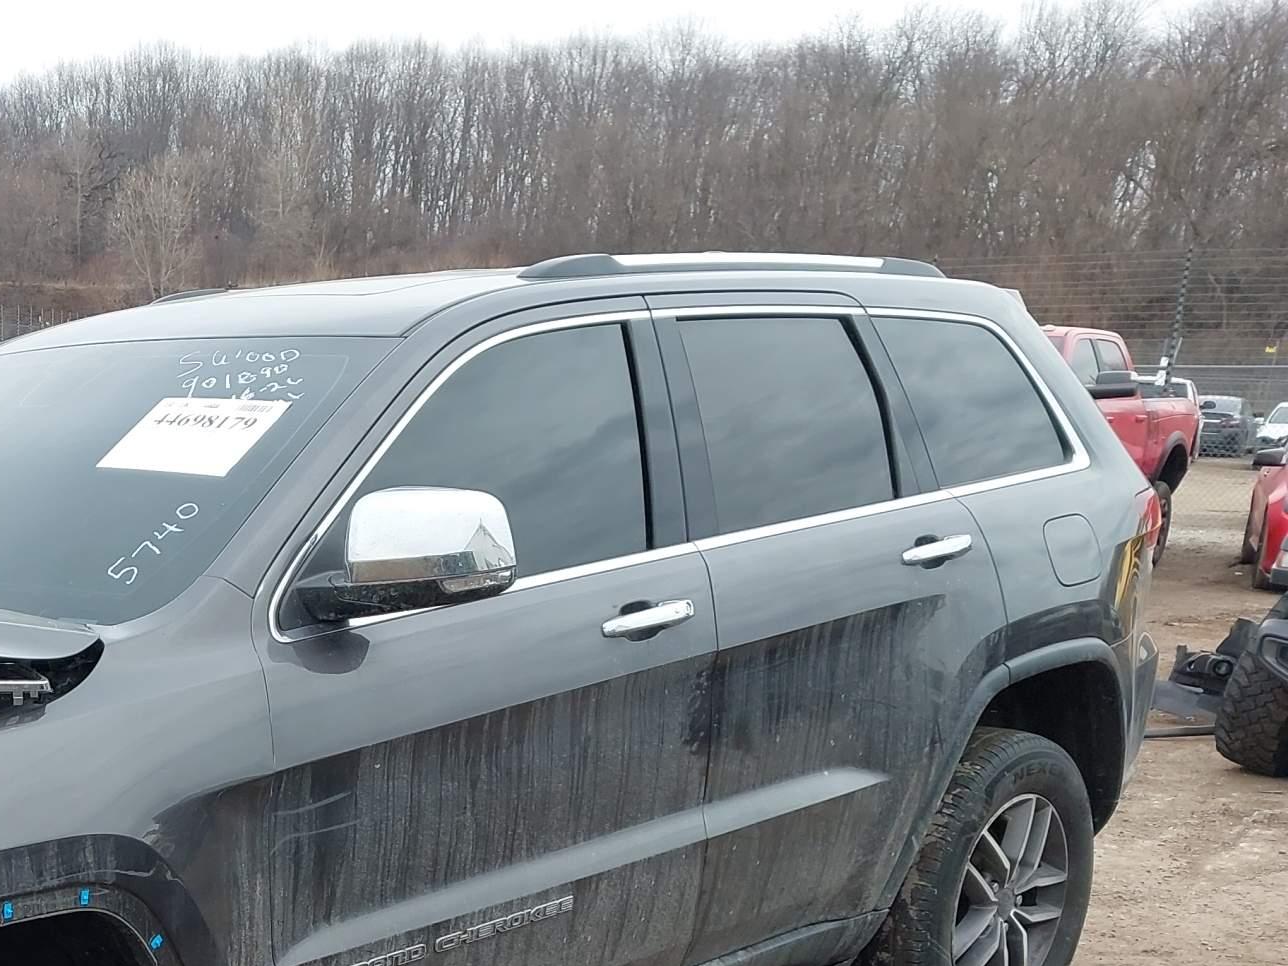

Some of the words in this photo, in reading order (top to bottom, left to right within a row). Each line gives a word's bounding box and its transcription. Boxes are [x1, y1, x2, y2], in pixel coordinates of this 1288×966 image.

[154, 413, 258, 430] 44698179
[107, 502, 199, 585] 5740
[435, 895, 574, 953] CHEROKEE
